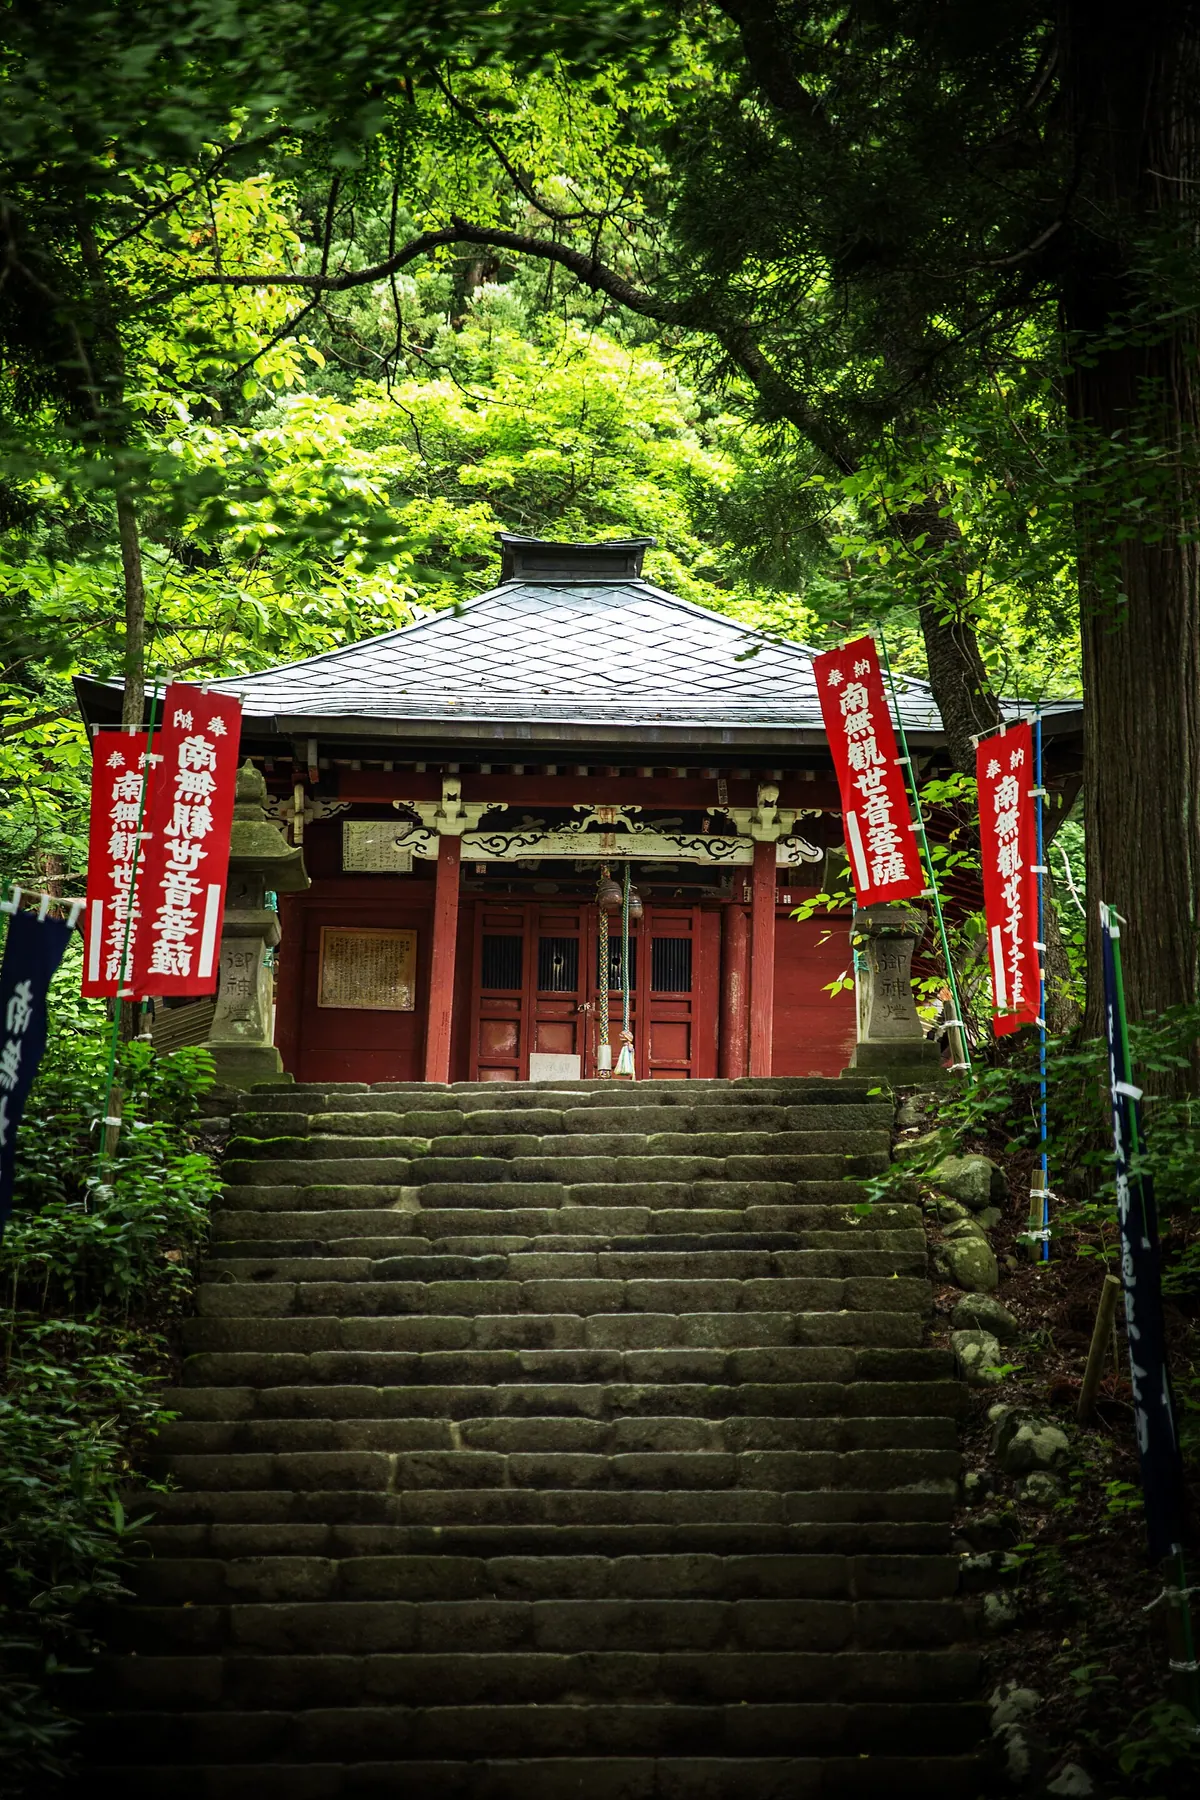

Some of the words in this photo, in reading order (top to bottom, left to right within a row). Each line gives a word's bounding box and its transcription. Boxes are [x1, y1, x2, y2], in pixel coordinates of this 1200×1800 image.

[827, 658, 871, 687] 奉納
[986, 747, 1025, 780] 奉納
[839, 681, 910, 887] 南無観世音菩薩
